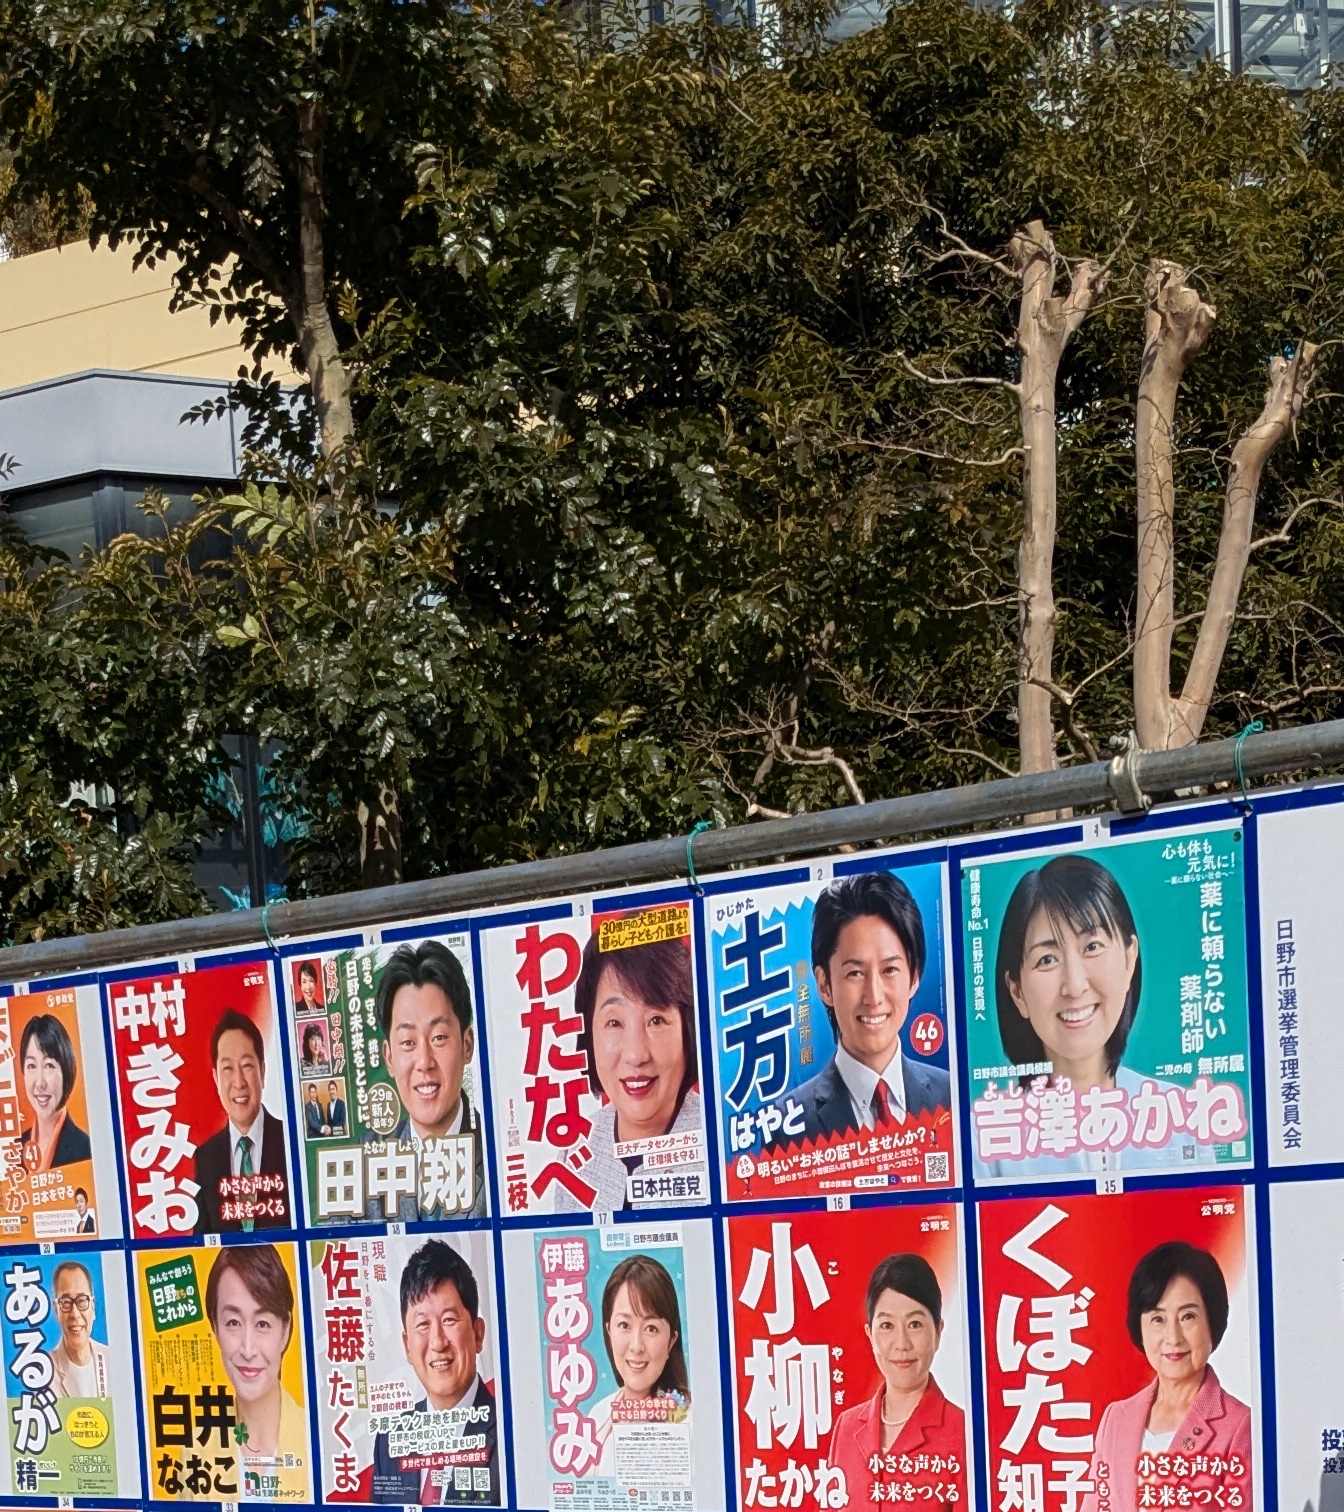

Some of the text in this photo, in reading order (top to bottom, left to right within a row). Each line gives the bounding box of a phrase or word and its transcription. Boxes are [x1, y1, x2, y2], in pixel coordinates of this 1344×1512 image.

[1161, 839, 1213, 860] 心も体も
[1187, 851, 1236, 873] 元気に!
[817, 868, 824, 881] 2
[579, 905, 585, 917] 3
[601, 909, 689, 936] 30億円の大型道路より
[715, 897, 755, 922] ひじかた
[969, 869, 986, 1022] 健康寿命 日野市の実現へ
[1199, 881, 1227, 1040] 薬に頼らない
[722, 909, 795, 1109] 土方
[1178, 975, 1205, 1055] 薬剤師
[345, 960, 374, 1131] 日野の未来をともに。
[915, 1022, 939, 1042] 46
[1275, 918, 1303, 1150] 日野市選挙管理委員会
[515, 924, 598, 1210] わたなべ
[1154, 1055, 1245, 1077] 二児の母 無所属
[982, 1075, 1072, 1101] よしざわ
[114, 978, 202, 1235] 中村 きみお
[371, 1101, 394, 1118] 新人
[973, 1078, 1244, 1160] 吉澤あかね
[730, 1101, 807, 1153] はやと
[363, 1139, 419, 1155] たなか しょう
[616, 1132, 699, 1157] 巨大データセンターから
[1, 1140, 30, 1215] さやか
[31, 1170, 64, 1189] 日野から
[219, 1173, 286, 1199] 小さな声から
[317, 1135, 475, 1218] 田中翔
[506, 1152, 529, 1212] 三枝
[631, 1175, 701, 1199] 日本共産党
[31, 1184, 75, 1206] 日本を守る
[833, 1197, 844, 1210] 16
[220, 1199, 286, 1222] 未来をつくる
[1199, 1203, 1236, 1217] 公明党
[919, 1220, 950, 1232] 公明党
[371, 1240, 387, 1283] 現職
[541, 1241, 586, 1274] 伊藤
[148, 1264, 193, 1286] みんなで創ろう
[157, 1300, 198, 1324] これから
[360, 1241, 376, 1362] 日野を1番にする会
[827, 1261, 845, 1406] こ やなぎ
[995, 1203, 1097, 1456] くぼた
[4, 1262, 61, 1454] あるが
[320, 1242, 366, 1492] 佐藤たくま
[737, 1221, 850, 1510] 小柳 たかね
[545, 1278, 599, 1473] あゆみ
[152, 1384, 237, 1449] 白井
[611, 1399, 676, 1410] 一人ひとりの幸せを
[369, 1407, 490, 1434] 多摩テック跡地を動かして
[15, 1459, 60, 1491] 精一
[156, 1452, 238, 1495] なおこ
[866, 1452, 962, 1475] 小さな声から
[1136, 1454, 1245, 1478] 小さな声から
[868, 1480, 960, 1503] 未来をつくる
[1137, 1483, 1244, 1509] 未来をつくる
